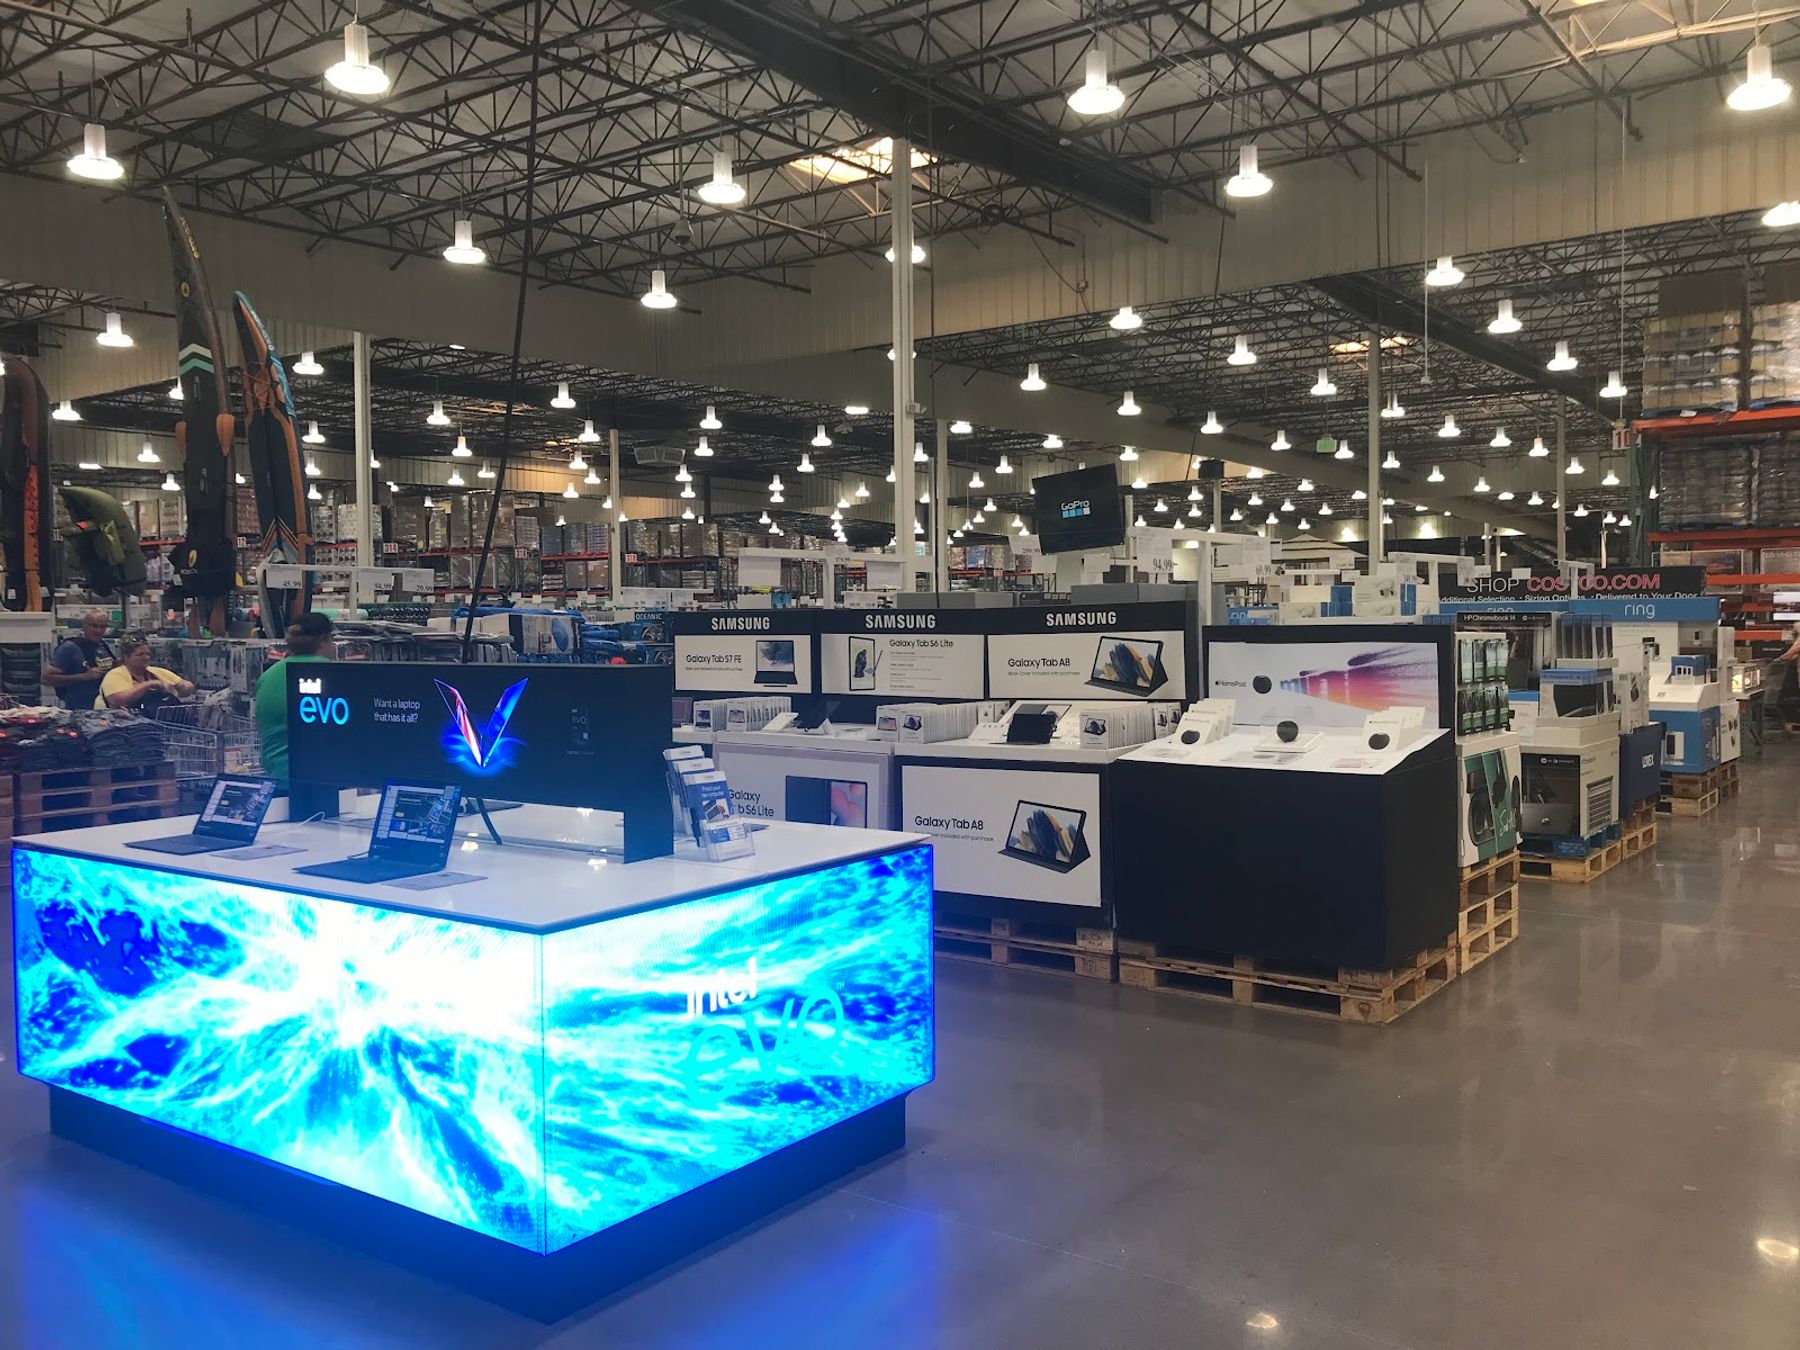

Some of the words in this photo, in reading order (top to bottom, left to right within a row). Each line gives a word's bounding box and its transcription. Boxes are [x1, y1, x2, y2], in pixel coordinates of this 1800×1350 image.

[1061, 500, 1090, 511] GoPro
[1153, 559, 1173, 571] 94.99
[1467, 578, 1520, 593] SHOP
[1624, 604, 1655, 619] ring
[711, 617, 771, 631] SAMSUNG
[864, 614, 936, 629] SAMSUNG
[1046, 611, 1117, 627] SAMSUNG
[889, 639, 915, 648] Galaxy
[917, 639, 930, 647] Tab
[940, 639, 954, 648] Lite
[686, 654, 711, 664] Galaxy
[712, 654, 725, 663] Tab
[725, 655, 734, 663] S7
[1008, 658, 1041, 669] Galaxy
[1041, 658, 1059, 667] Tab
[1059, 658, 1071, 667] A8
[299, 696, 350, 725] evo
[374, 698, 391, 708] Want
[398, 699, 420, 711] laptop
[374, 712, 388, 722] that
[388, 712, 400, 722] has
[406, 712, 418, 723] all?
[746, 804, 757, 815] S6
[758, 804, 775, 817] Lite
[914, 815, 951, 830] Galaxy
[951, 818, 970, 829] Tab
[970, 819, 984, 830] A8
